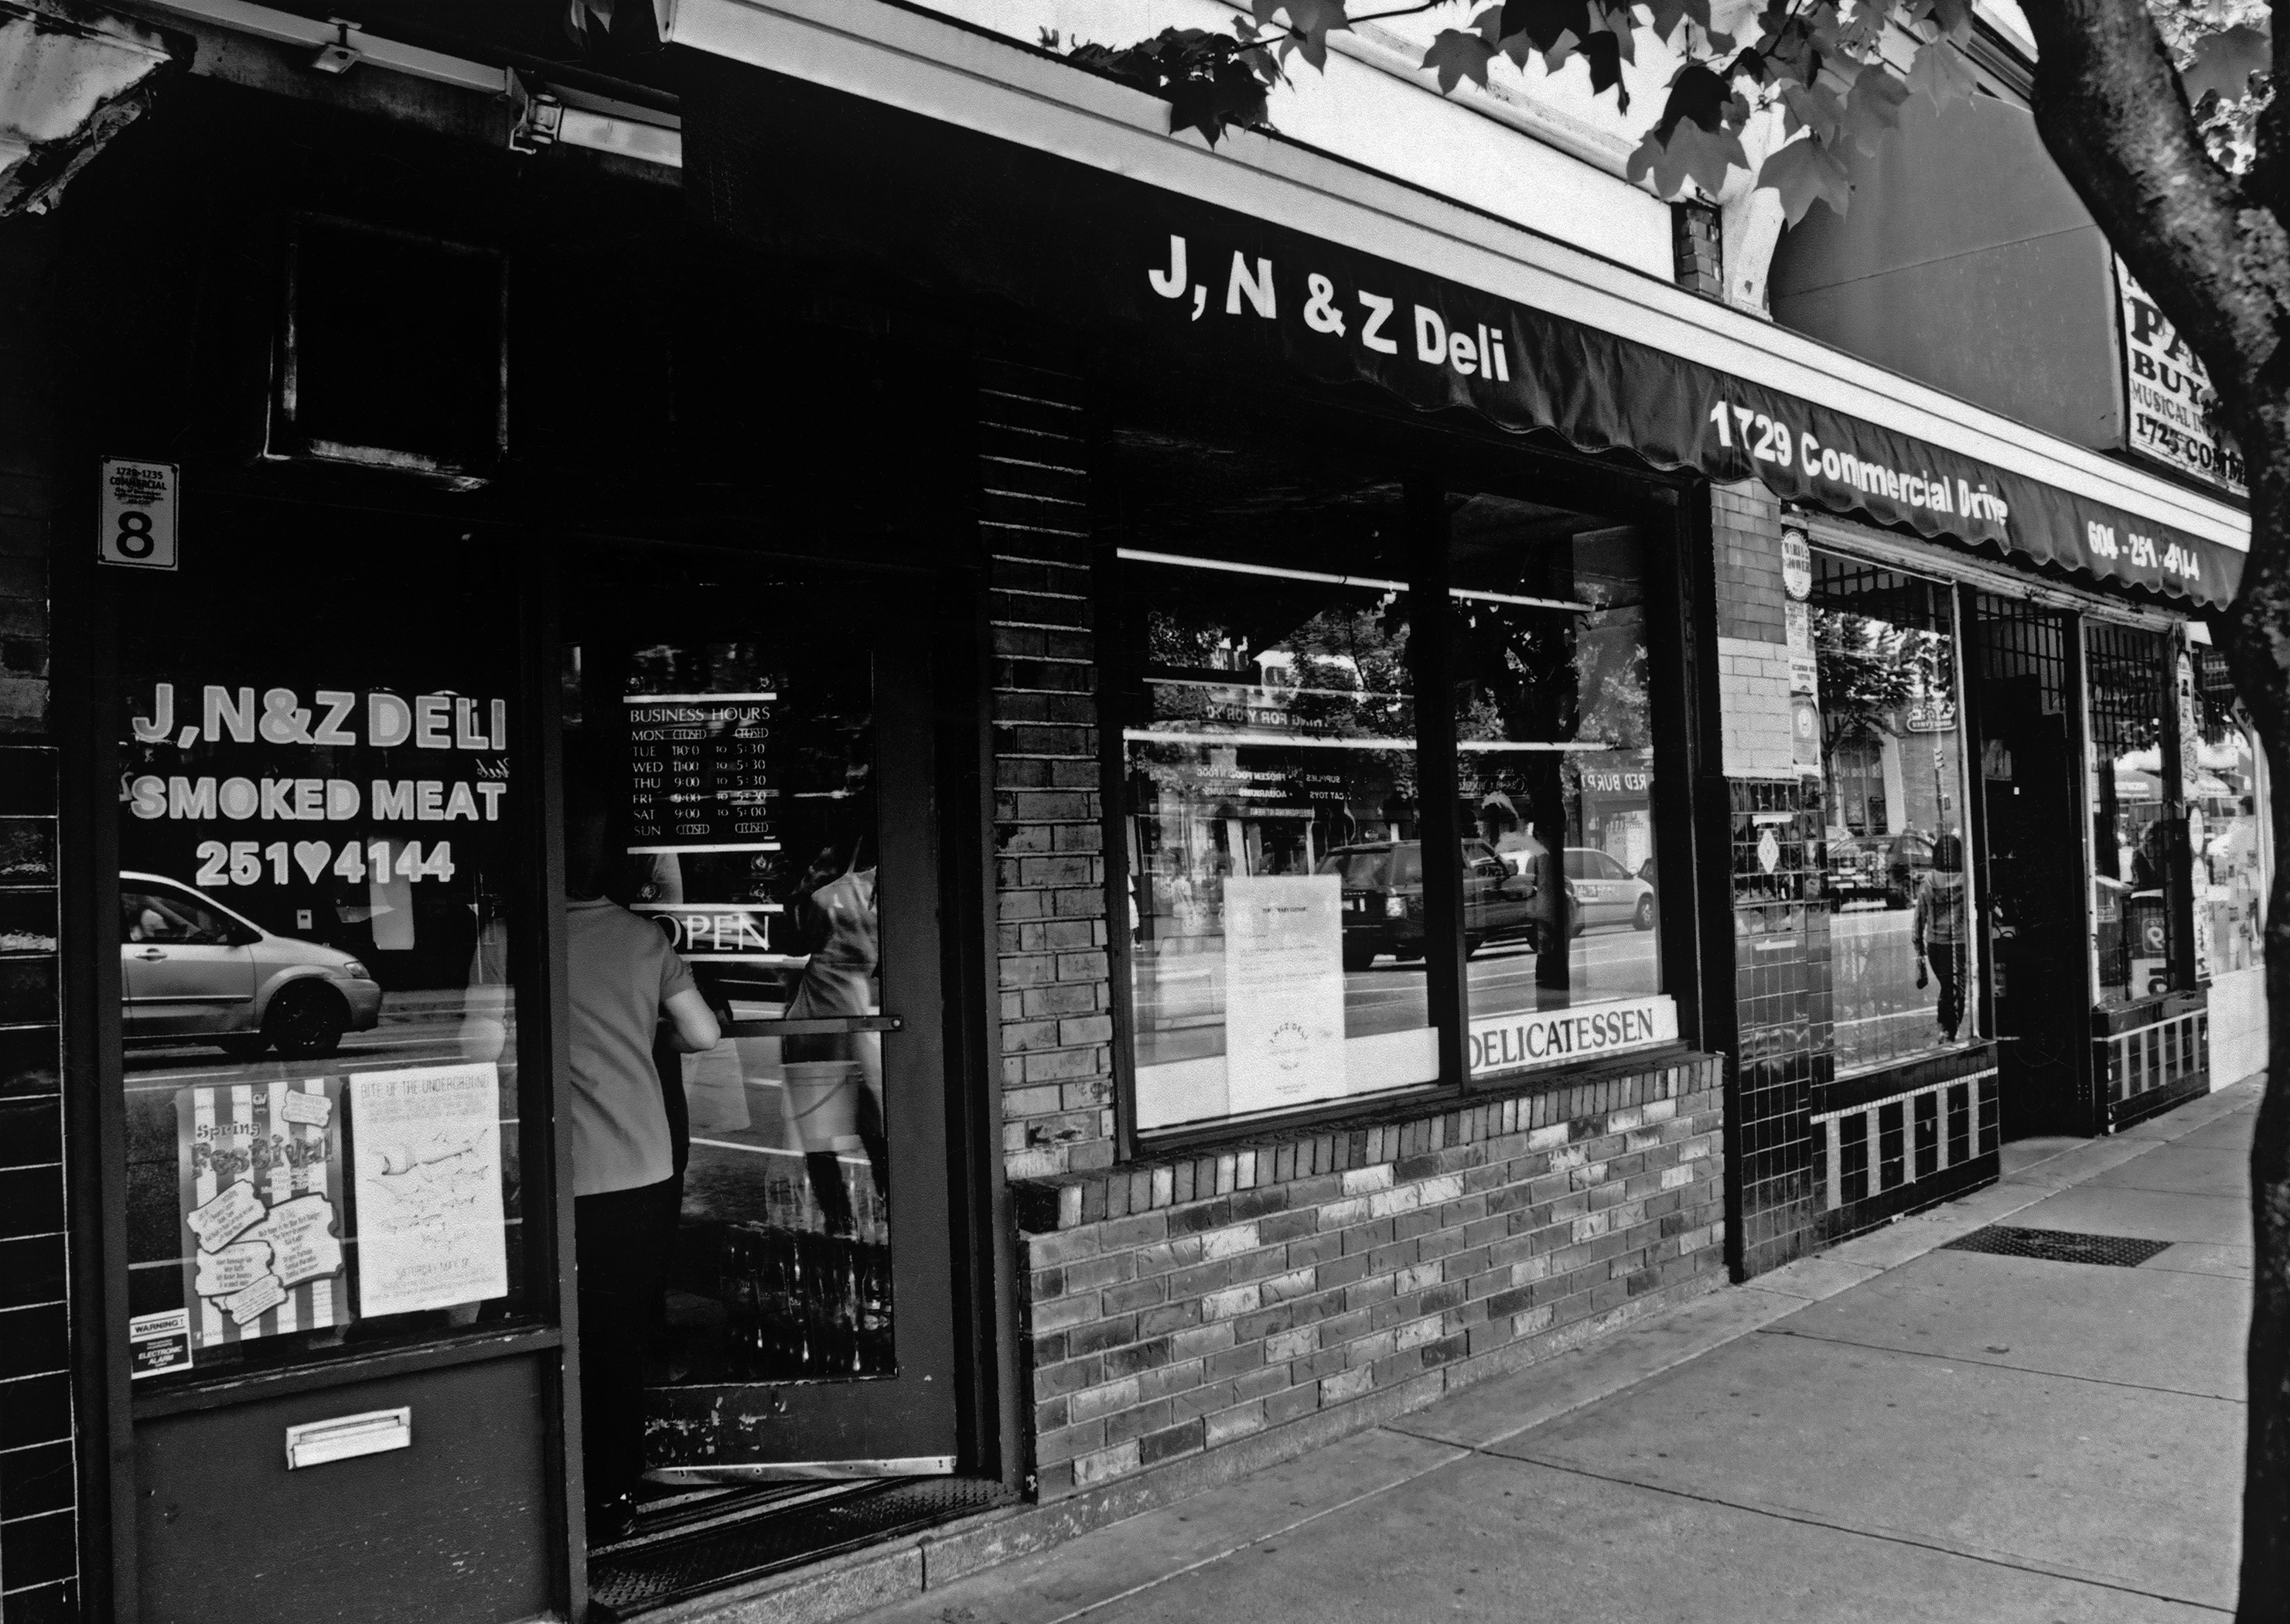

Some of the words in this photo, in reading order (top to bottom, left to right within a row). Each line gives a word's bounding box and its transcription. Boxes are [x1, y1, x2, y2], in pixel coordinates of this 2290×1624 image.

[1226, 250, 1277, 319] N
[1303, 272, 1346, 337] &
[1358, 289, 1398, 354] Z
[1414, 303, 1510, 382] Deli
[2130, 379, 2190, 428] MUSICAL
[1710, 400, 1793, 467] 1729
[1800, 431, 1954, 513] Commercial
[116, 510, 155, 559] 8
[368, 692, 507, 750] DELI
[630, 708, 705, 723] BUSINESS
[712, 707, 771, 722] HOURS
[631, 729, 664, 742] MON
[673, 728, 708, 740] CLOSED
[633, 745, 657, 758] TUE
[736, 743, 766, 755] 5:30
[632, 761, 664, 773] WED
[736, 759, 766, 771] 5:30
[633, 777, 661, 789] THU
[673, 776, 700, 788] 9:00
[736, 775, 766, 786] 5:30
[131, 775, 361, 821] SMOKED
[371, 780, 507, 821] MEAT
[633, 793, 653, 804] FRI
[633, 809, 657, 821] SAT
[674, 808, 701, 820] 9:00
[736, 807, 766, 818] 5:00
[634, 825, 661, 837] SUN
[1469, 1007, 1654, 1071] DELICATESSEN
[196, 1121, 262, 1141] Spring
[135, 1319, 179, 1333] WARNING
[138, 1345, 183, 1360] ELECTRONIC
[148, 1353, 175, 1366] ALARM
